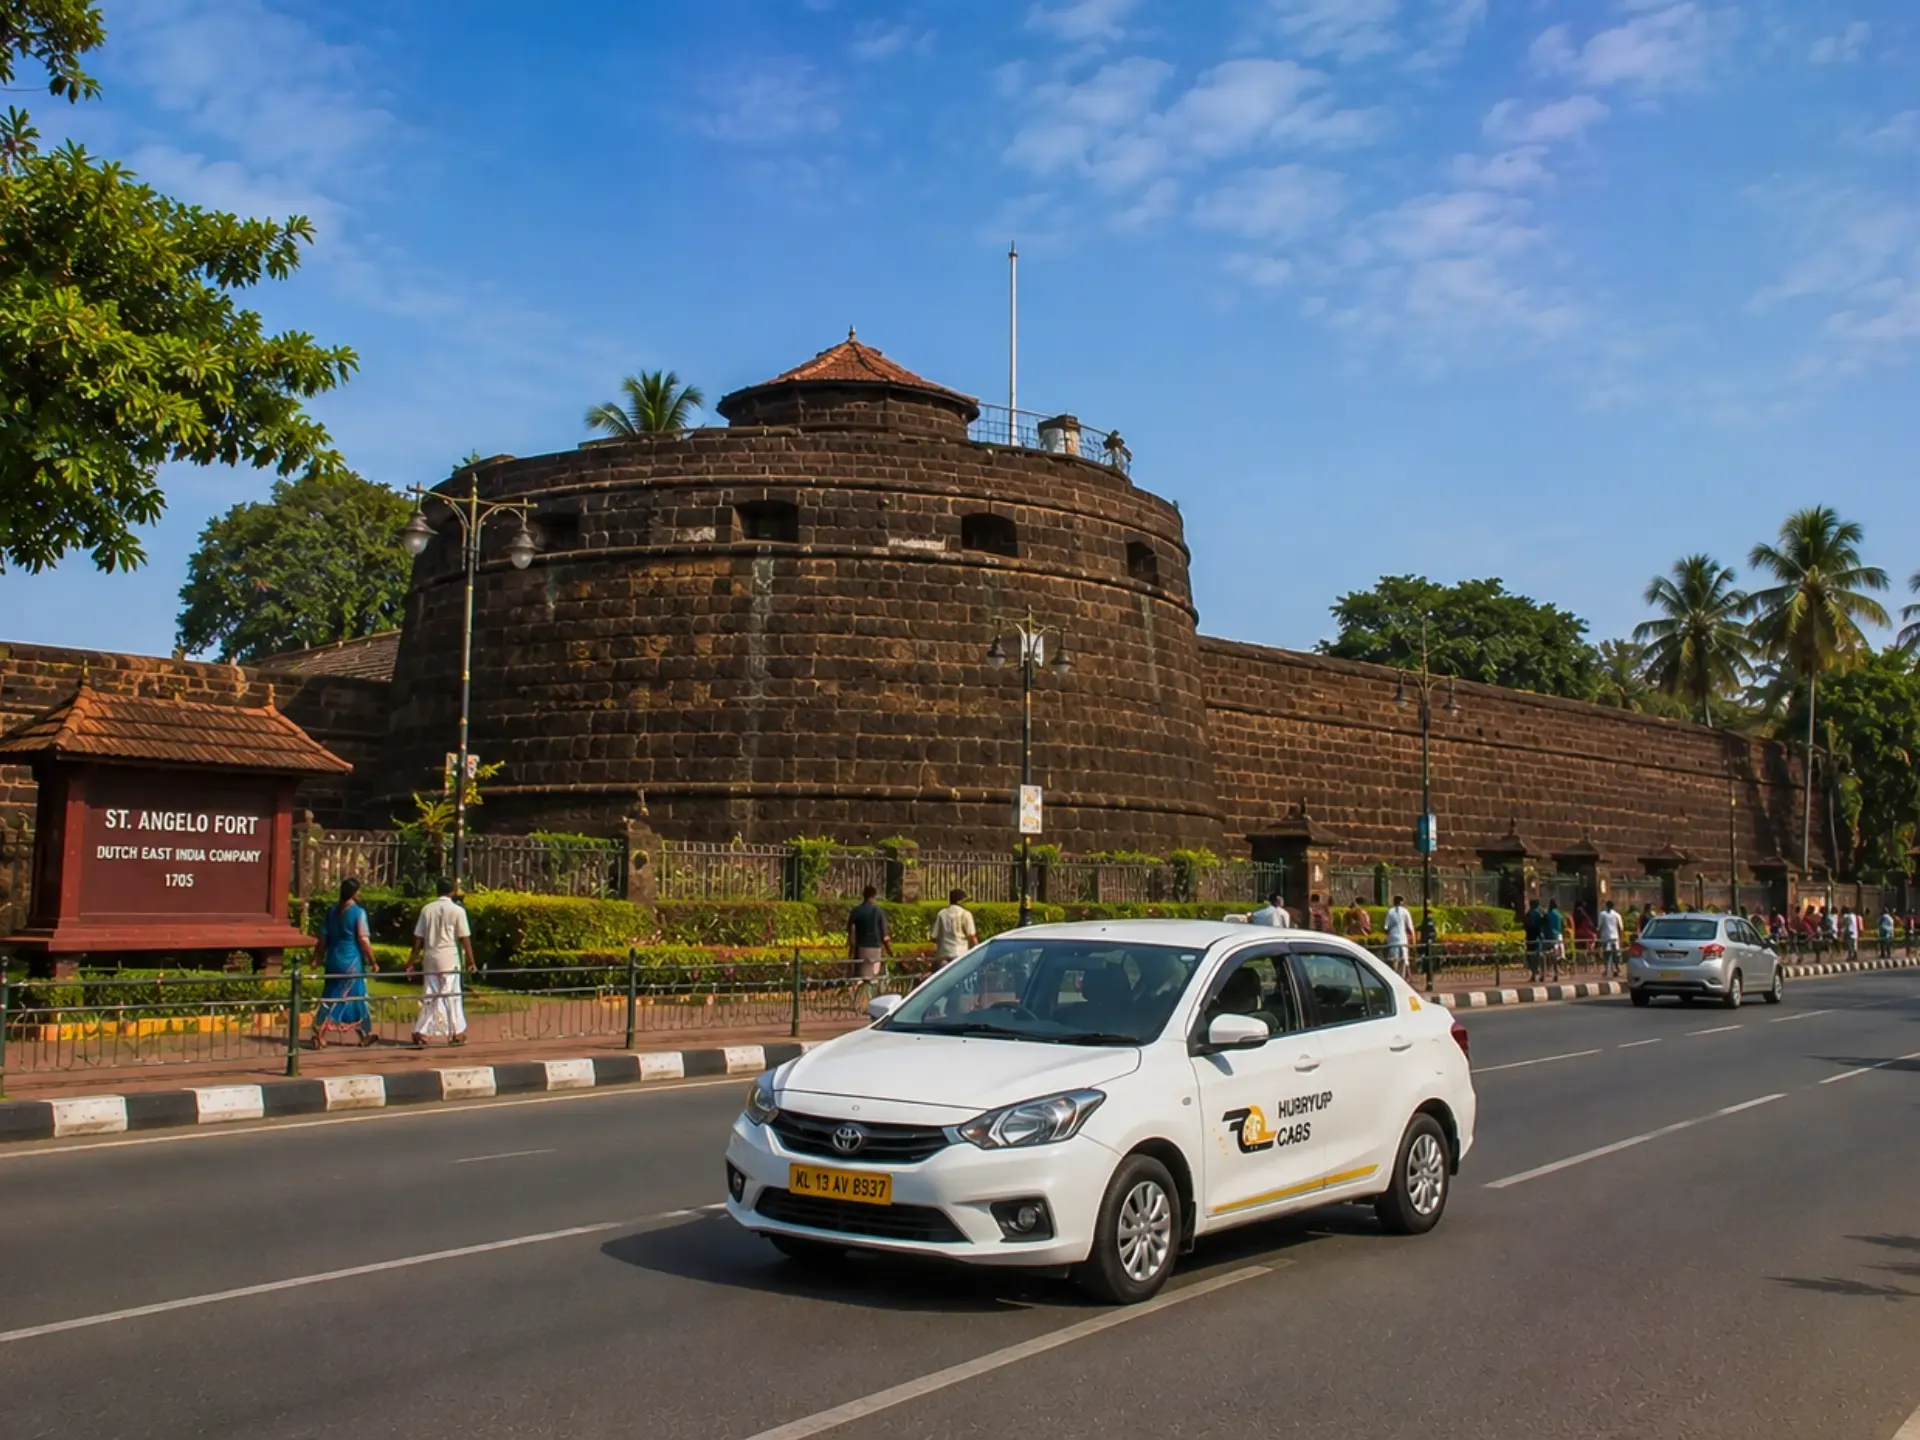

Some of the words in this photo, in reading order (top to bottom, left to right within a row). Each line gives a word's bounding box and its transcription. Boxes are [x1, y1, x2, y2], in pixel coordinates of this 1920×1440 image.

[105, 809, 131, 829] ST.
[138, 812, 208, 833] ANGELO
[214, 815, 259, 835] FORT
[97, 846, 138, 860] DUTCH
[141, 848, 172, 860] EAST
[175, 848, 206, 861] INDIA
[209, 850, 261, 863] COMPANY
[165, 873, 194, 887] 1705
[1278, 1091, 1333, 1119] HURRYUP
[1277, 1122, 1311, 1147] CABS
[795, 1170, 810, 1189] KL
[816, 1173, 829, 1191] 13
[832, 1176, 849, 1194] AV
